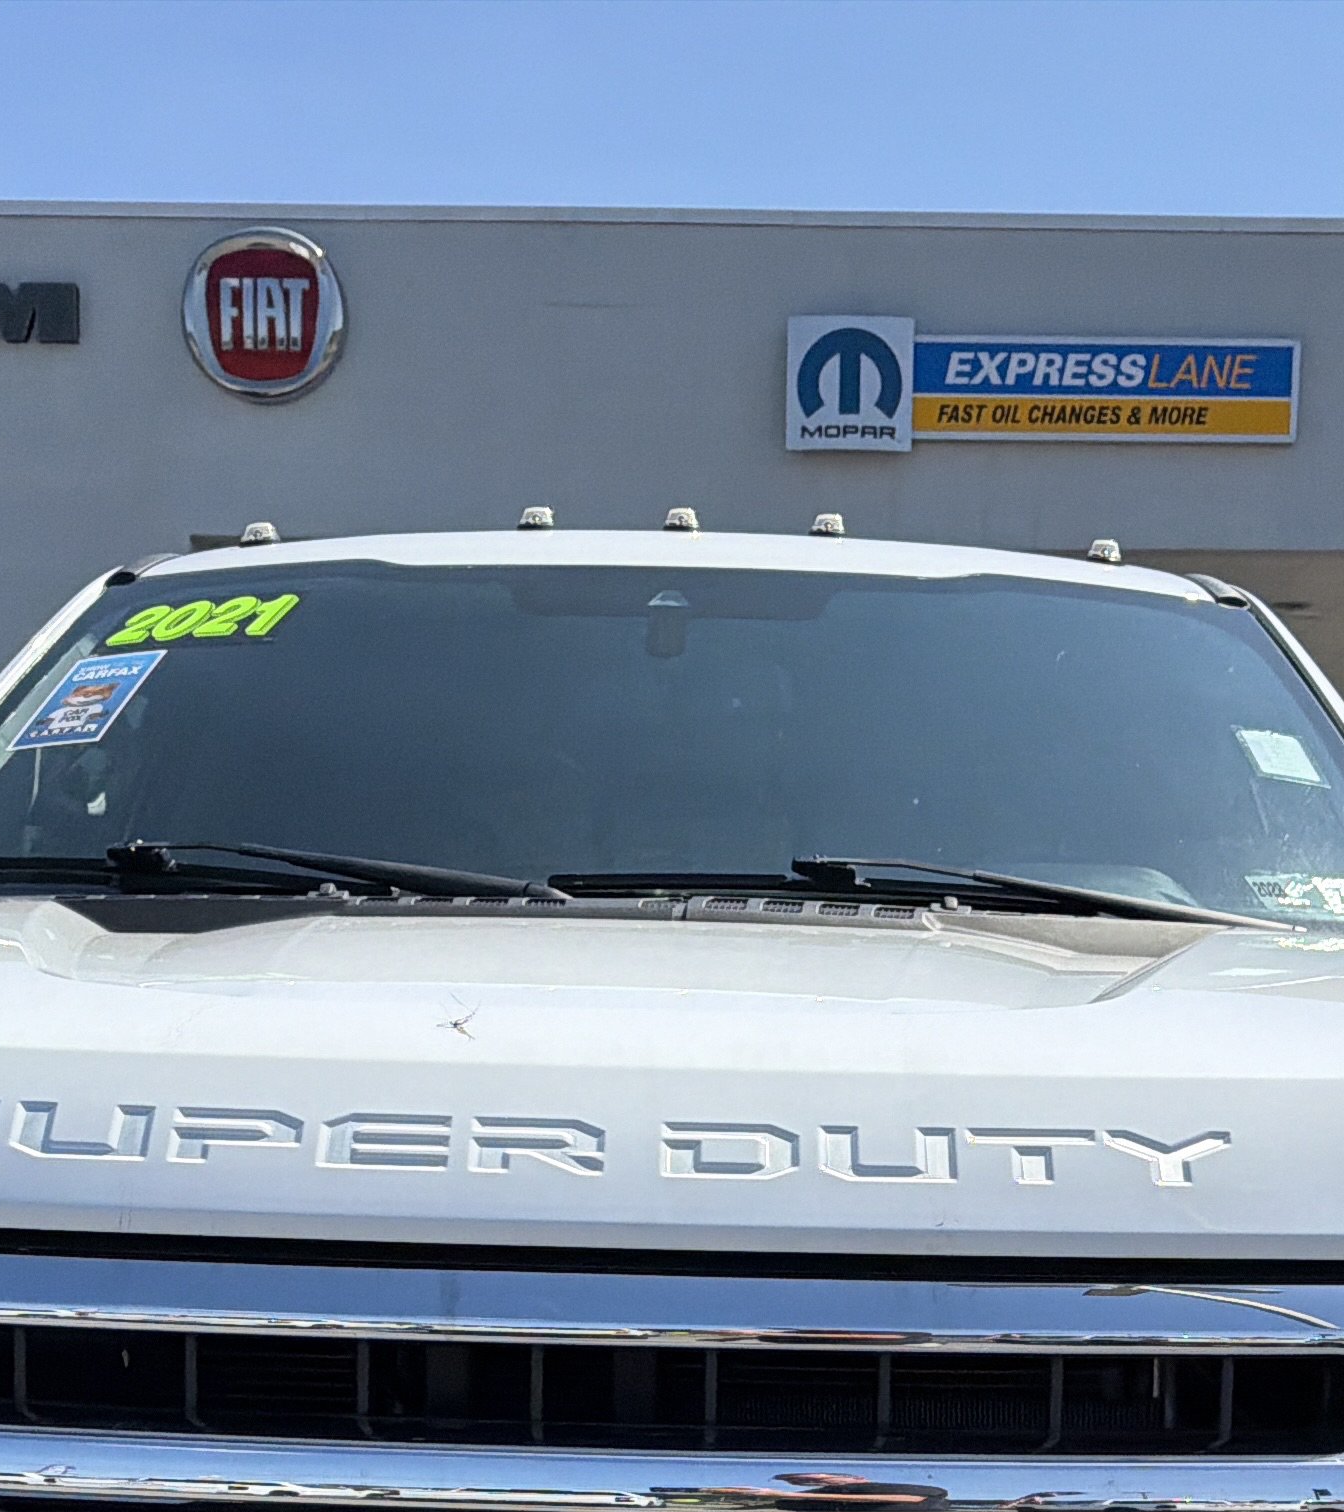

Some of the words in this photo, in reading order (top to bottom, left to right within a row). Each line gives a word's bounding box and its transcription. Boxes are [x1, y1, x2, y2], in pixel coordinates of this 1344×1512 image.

[219, 277, 311, 351] FIAT
[800, 424, 897, 440] MOPAR
[937, 403, 988, 424] FAST
[991, 404, 1022, 425] OIL
[1027, 405, 1121, 426] CHANGES
[1126, 407, 1142, 426] &
[1147, 406, 1209, 427] MORE
[106, 593, 300, 646] 2021
[71, 664, 144, 682] CARFAX
[659, 1120, 1232, 1187] DUTY
